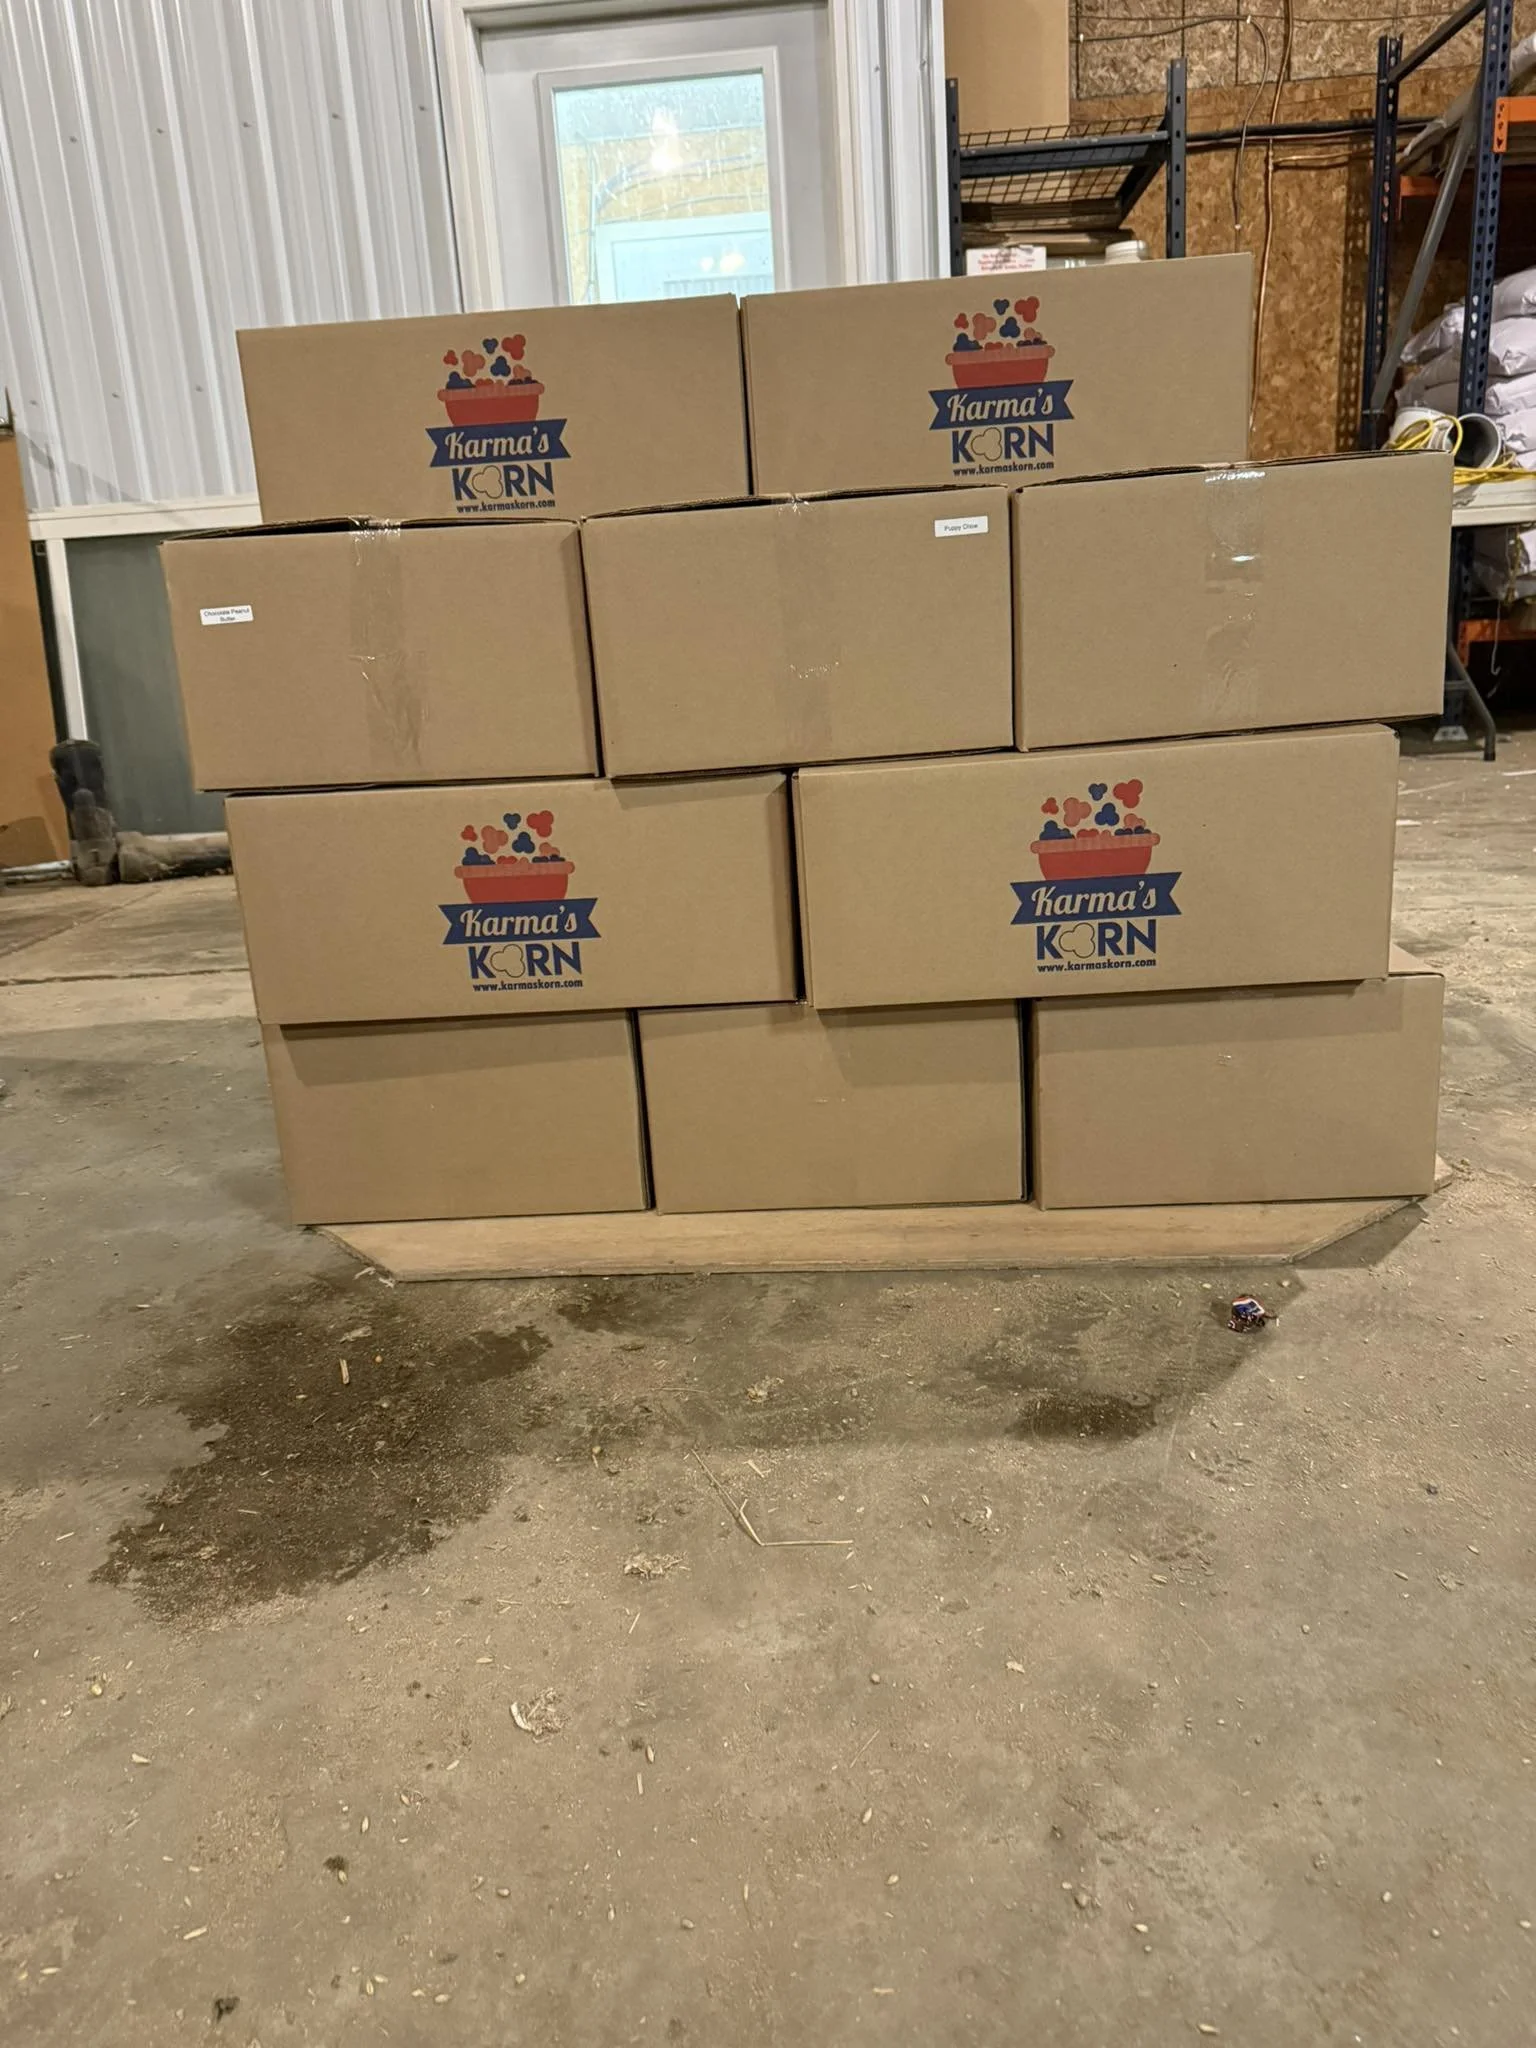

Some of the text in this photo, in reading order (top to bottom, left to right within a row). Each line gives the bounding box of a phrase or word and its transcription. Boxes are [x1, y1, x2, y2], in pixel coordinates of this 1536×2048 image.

[946, 387, 1054, 423] Karma's
[444, 425, 550, 460] Karma's
[953, 461, 1055, 476] www.karmaskorn.com
[456, 499, 556, 513] www.karmaskorn.com
[1031, 880, 1157, 917] Karma's
[460, 904, 578, 937] Karma's
[1037, 958, 1156, 973] www.karmaskorn.com
[473, 979, 583, 992] www.karmaskorn.com
